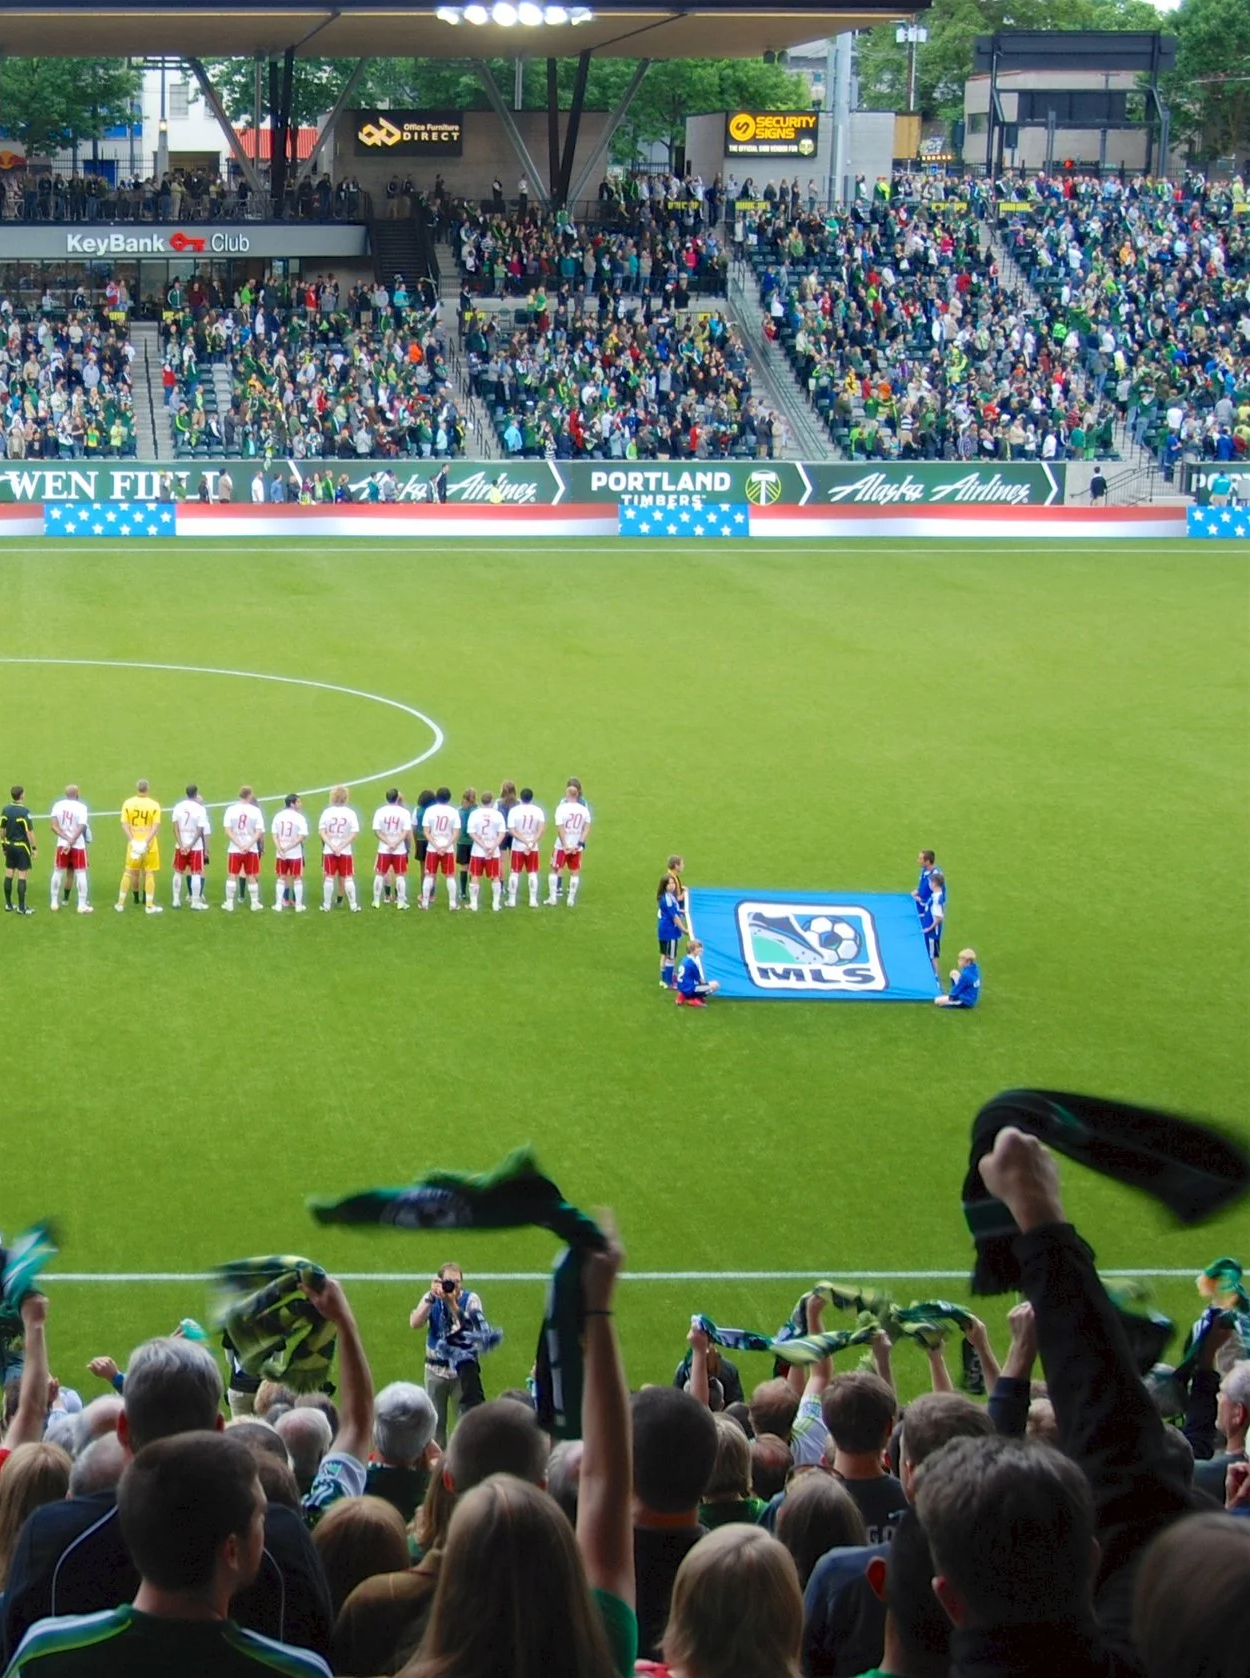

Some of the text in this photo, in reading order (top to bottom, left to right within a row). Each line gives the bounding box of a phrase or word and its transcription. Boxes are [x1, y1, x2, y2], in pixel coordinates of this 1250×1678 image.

[403, 123, 460, 131] Office Furniture
[755, 116, 816, 128] SECURITY
[403, 132, 460, 141] DIRECT
[755, 128, 795, 139] SIGNS
[66, 233, 250, 256] KeyBank Club
[591, 471, 731, 491] PORTLAND
[828, 472, 1031, 505] Alaska Airlines
[62, 810, 74, 825] 14
[132, 810, 149, 827] 24
[183, 811, 190, 826] 7
[237, 814, 248, 830] 8
[329, 817, 347, 834] 22
[383, 815, 400, 831] 44
[435, 816, 449, 830] 10
[565, 813, 583, 829] 20
[280, 821, 293, 837] 13
[481, 819, 491, 836] 2
[757, 966, 876, 984] MLS
